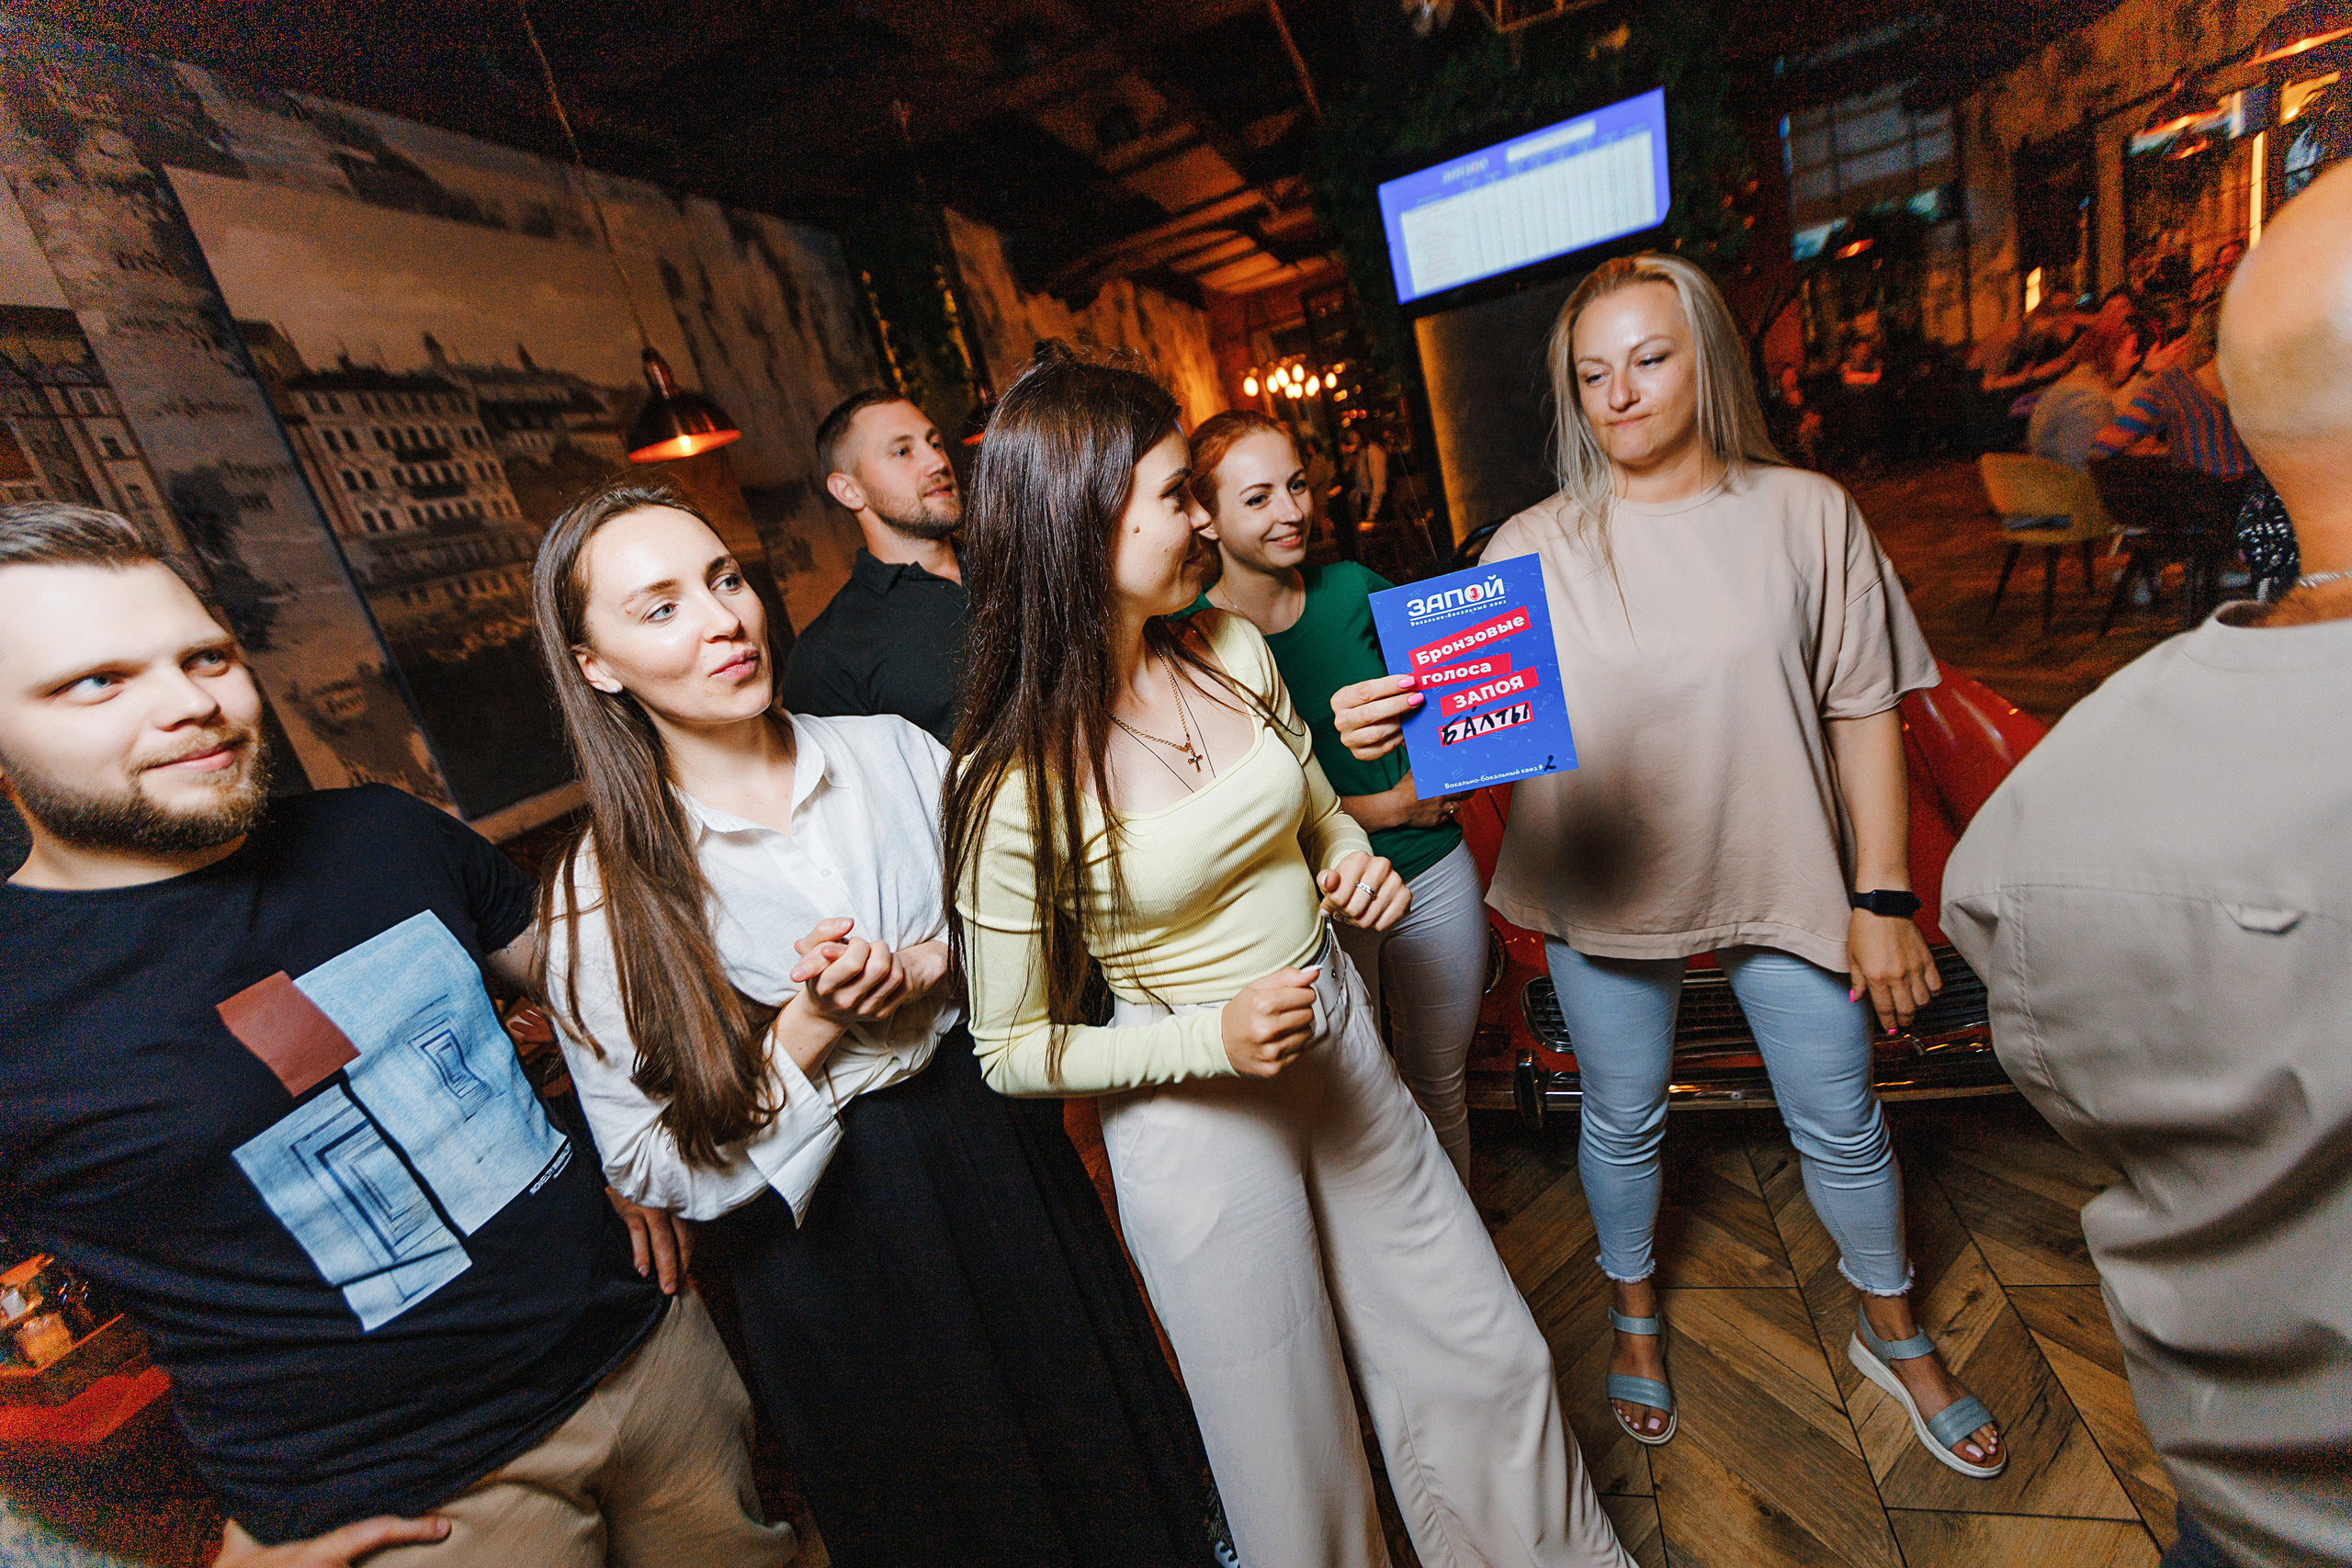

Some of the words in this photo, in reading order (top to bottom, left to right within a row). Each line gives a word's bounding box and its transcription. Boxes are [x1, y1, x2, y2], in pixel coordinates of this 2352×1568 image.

[1407, 574, 1505, 617] ЗАПОЙ
[1410, 604, 1487, 626] Вокально-бокальный
[1416, 615, 1525, 665] Бронзовые
[1421, 662, 1492, 685] голоса
[1453, 675, 1525, 708] ЗАПОЯ
[1444, 769, 1521, 789] Вокально-бокальный
[1521, 765, 1538, 774] квиз
